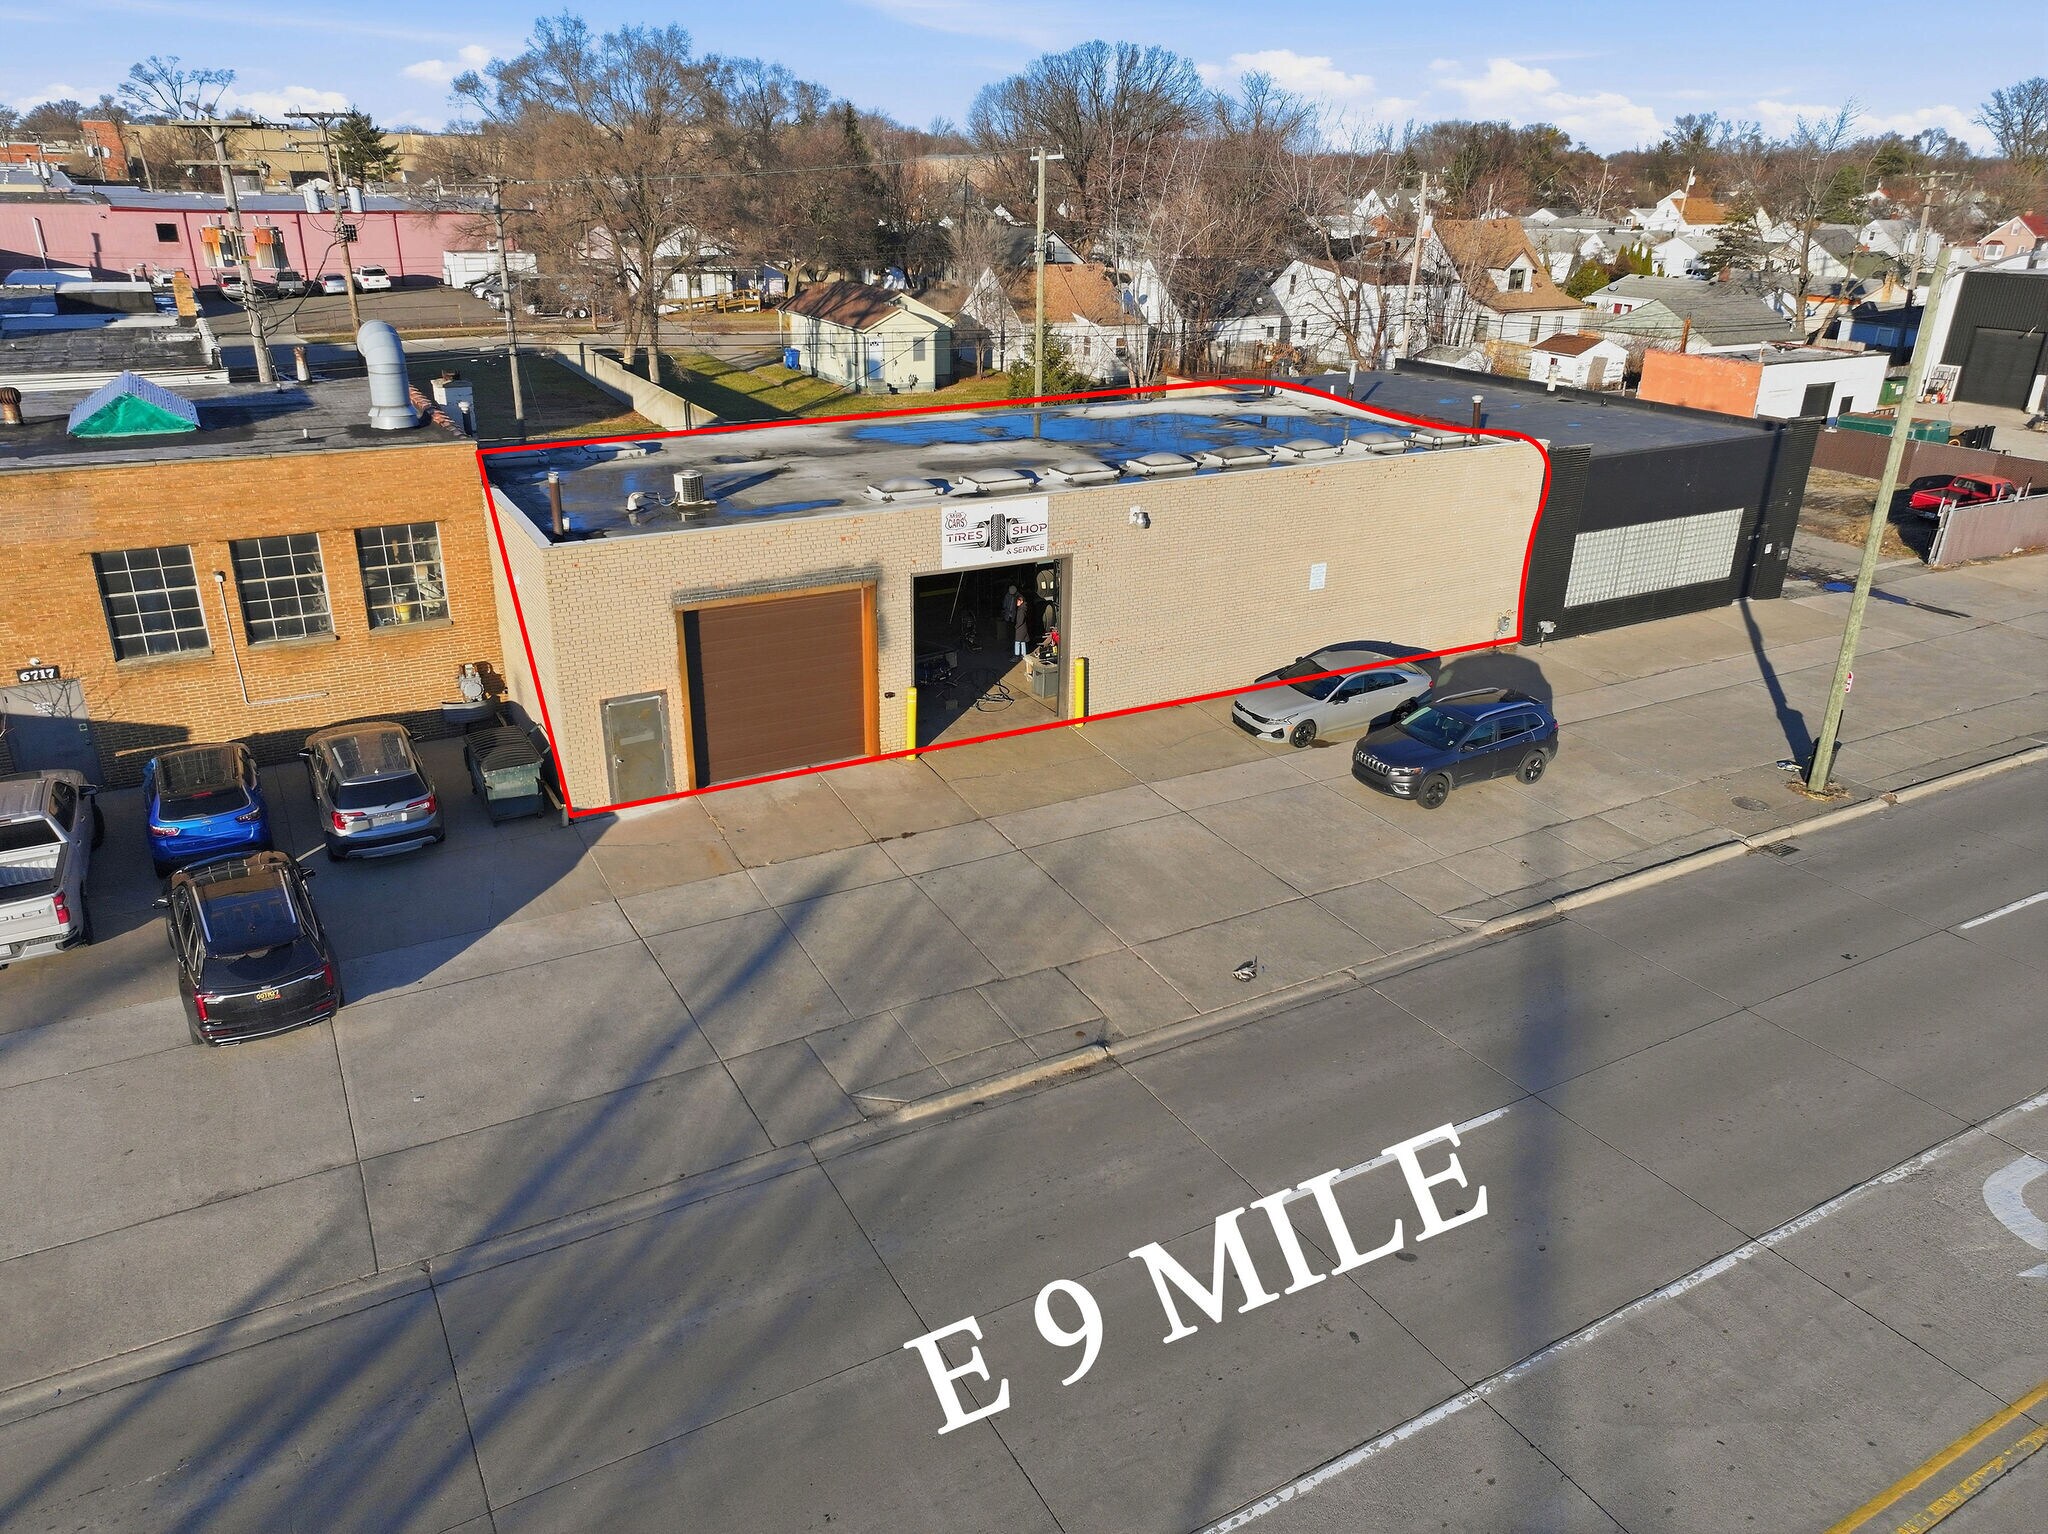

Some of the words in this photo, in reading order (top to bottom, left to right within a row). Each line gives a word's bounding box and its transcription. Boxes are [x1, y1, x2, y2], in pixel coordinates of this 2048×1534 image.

[948, 518, 965, 529] CARS
[946, 531, 983, 542] TIRES
[1012, 523, 1047, 535] SHOP
[1013, 544, 1045, 554] SERVICE
[20, 668, 55, 682] 6717
